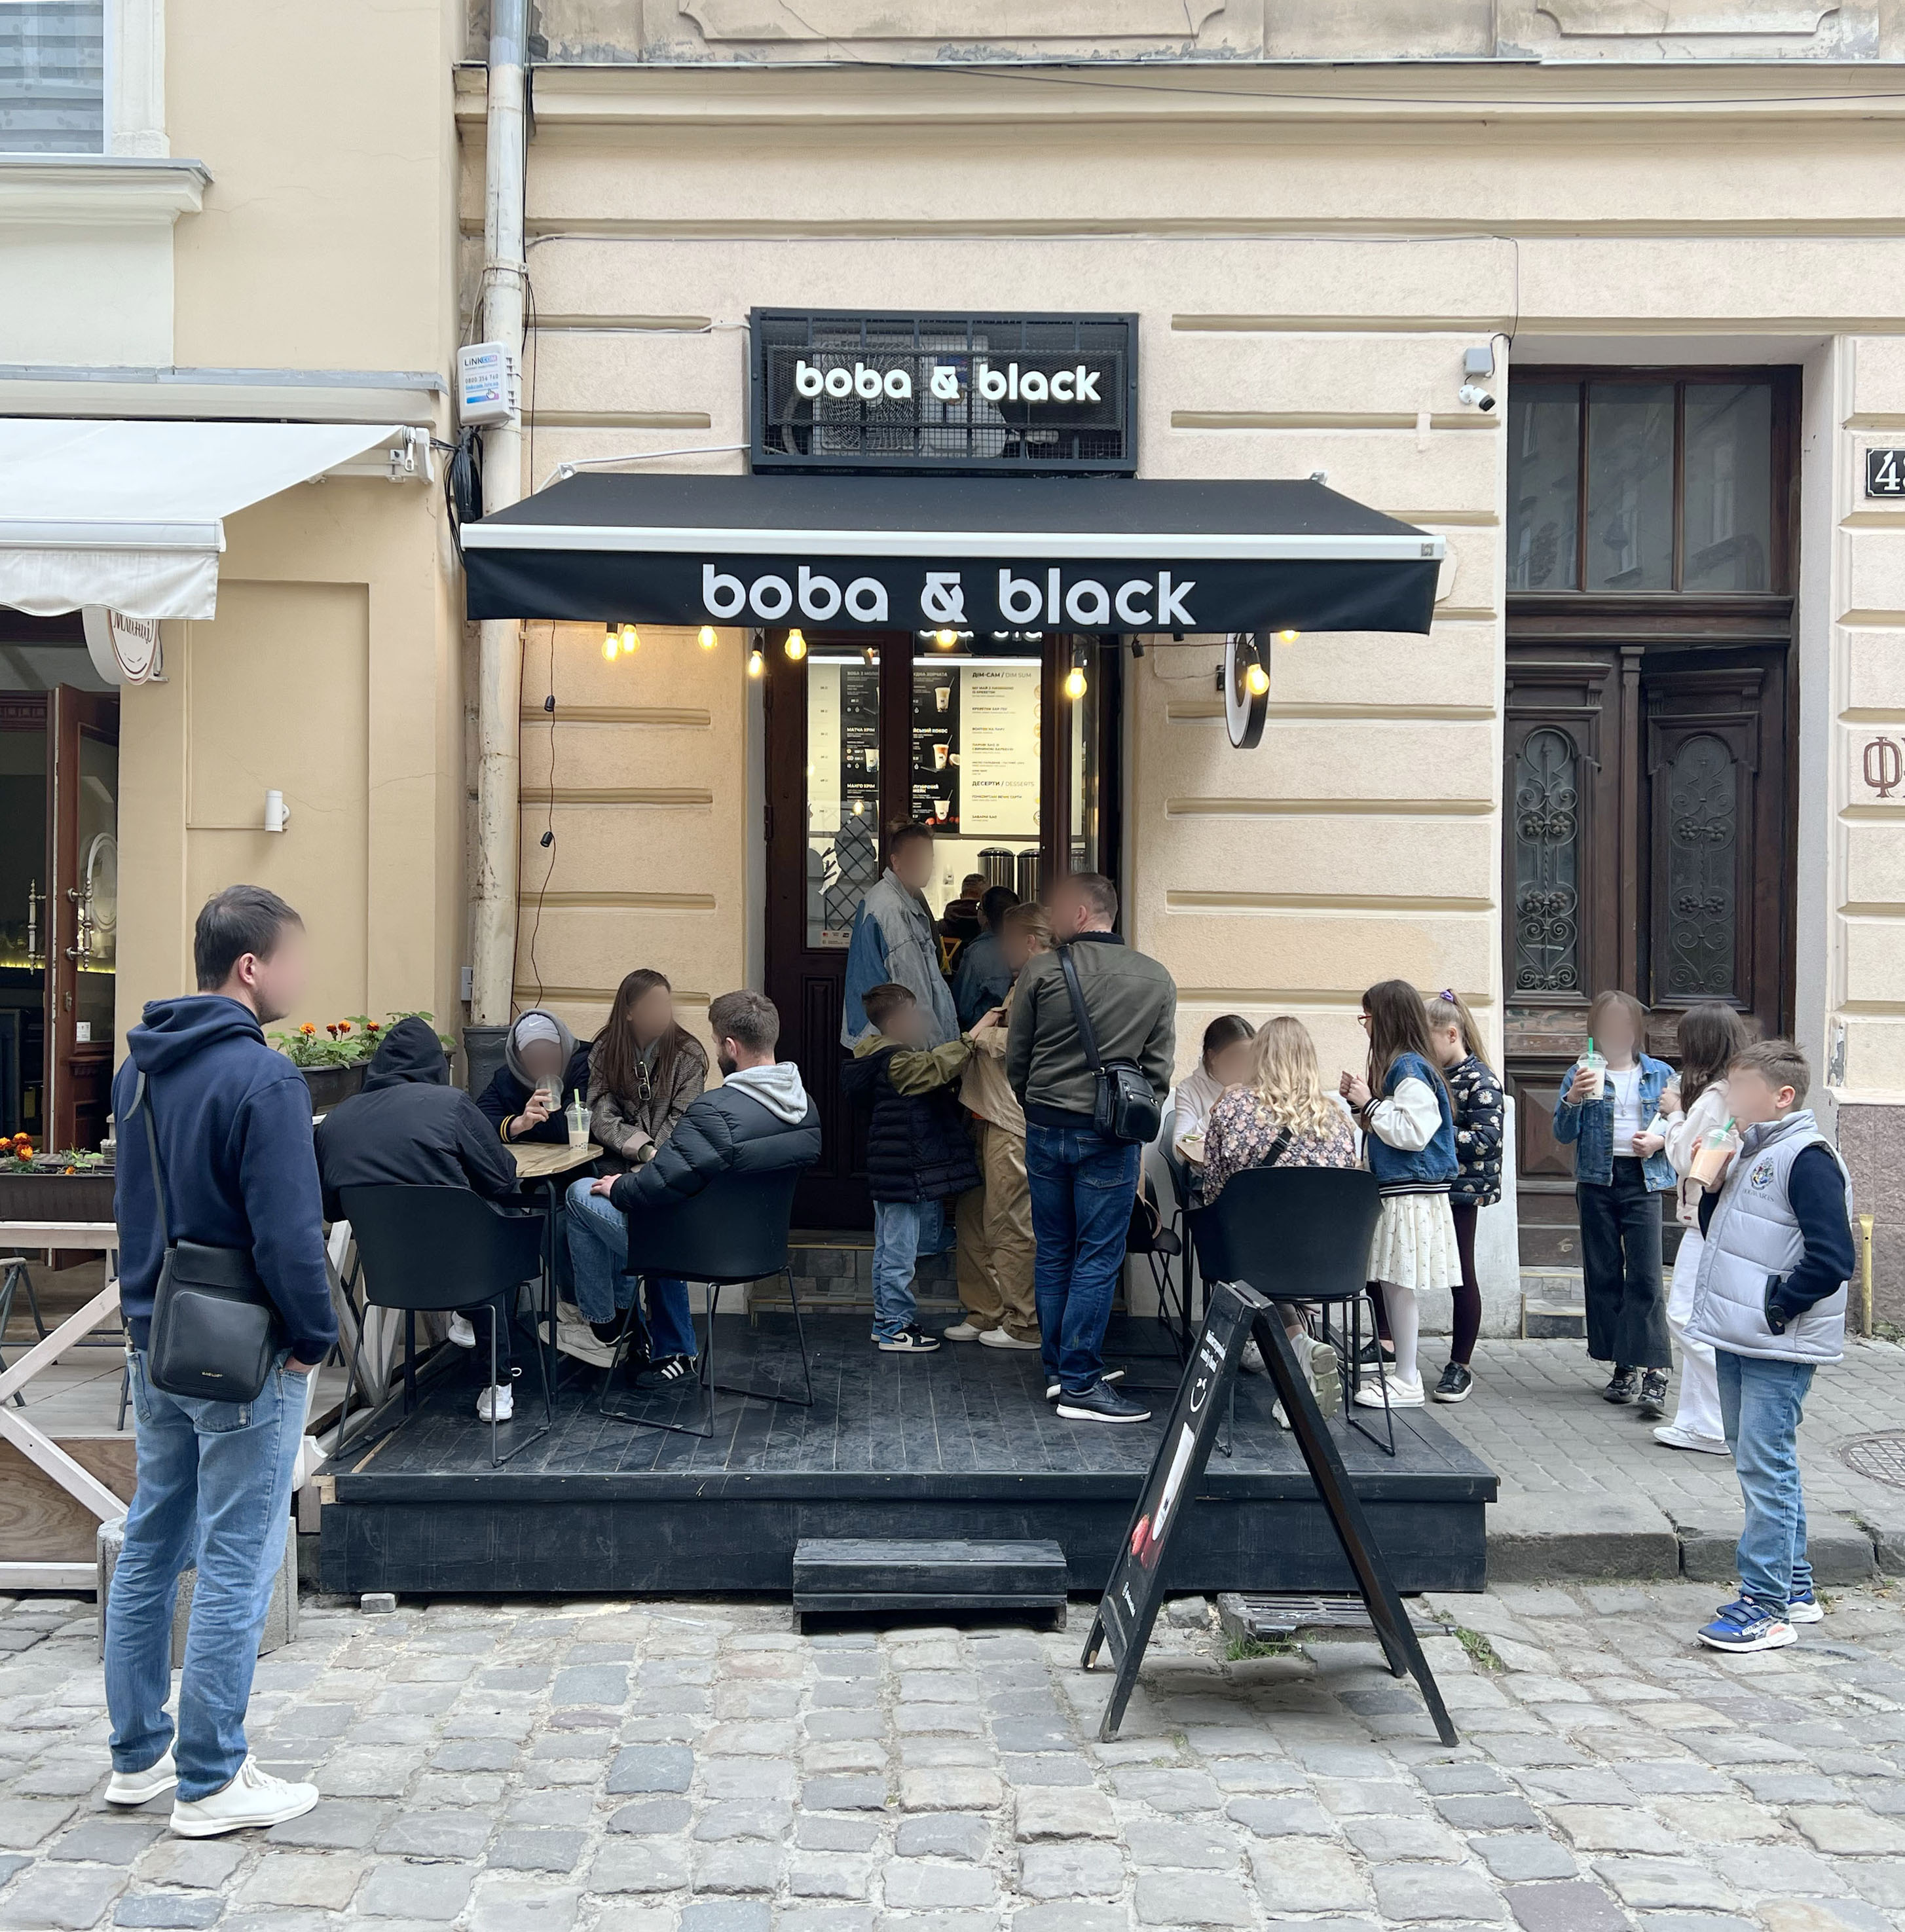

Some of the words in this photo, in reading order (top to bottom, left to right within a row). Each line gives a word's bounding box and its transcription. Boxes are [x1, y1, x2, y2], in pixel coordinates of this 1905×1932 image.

[796, 360, 912, 399] boba
[931, 366, 960, 399] &
[980, 363, 1101, 401] black
[1875, 450, 1905, 490] 4
[703, 563, 888, 621] boba
[921, 572, 968, 624] &
[999, 567, 1196, 625] black
[113, 612, 154, 644] Млинці
